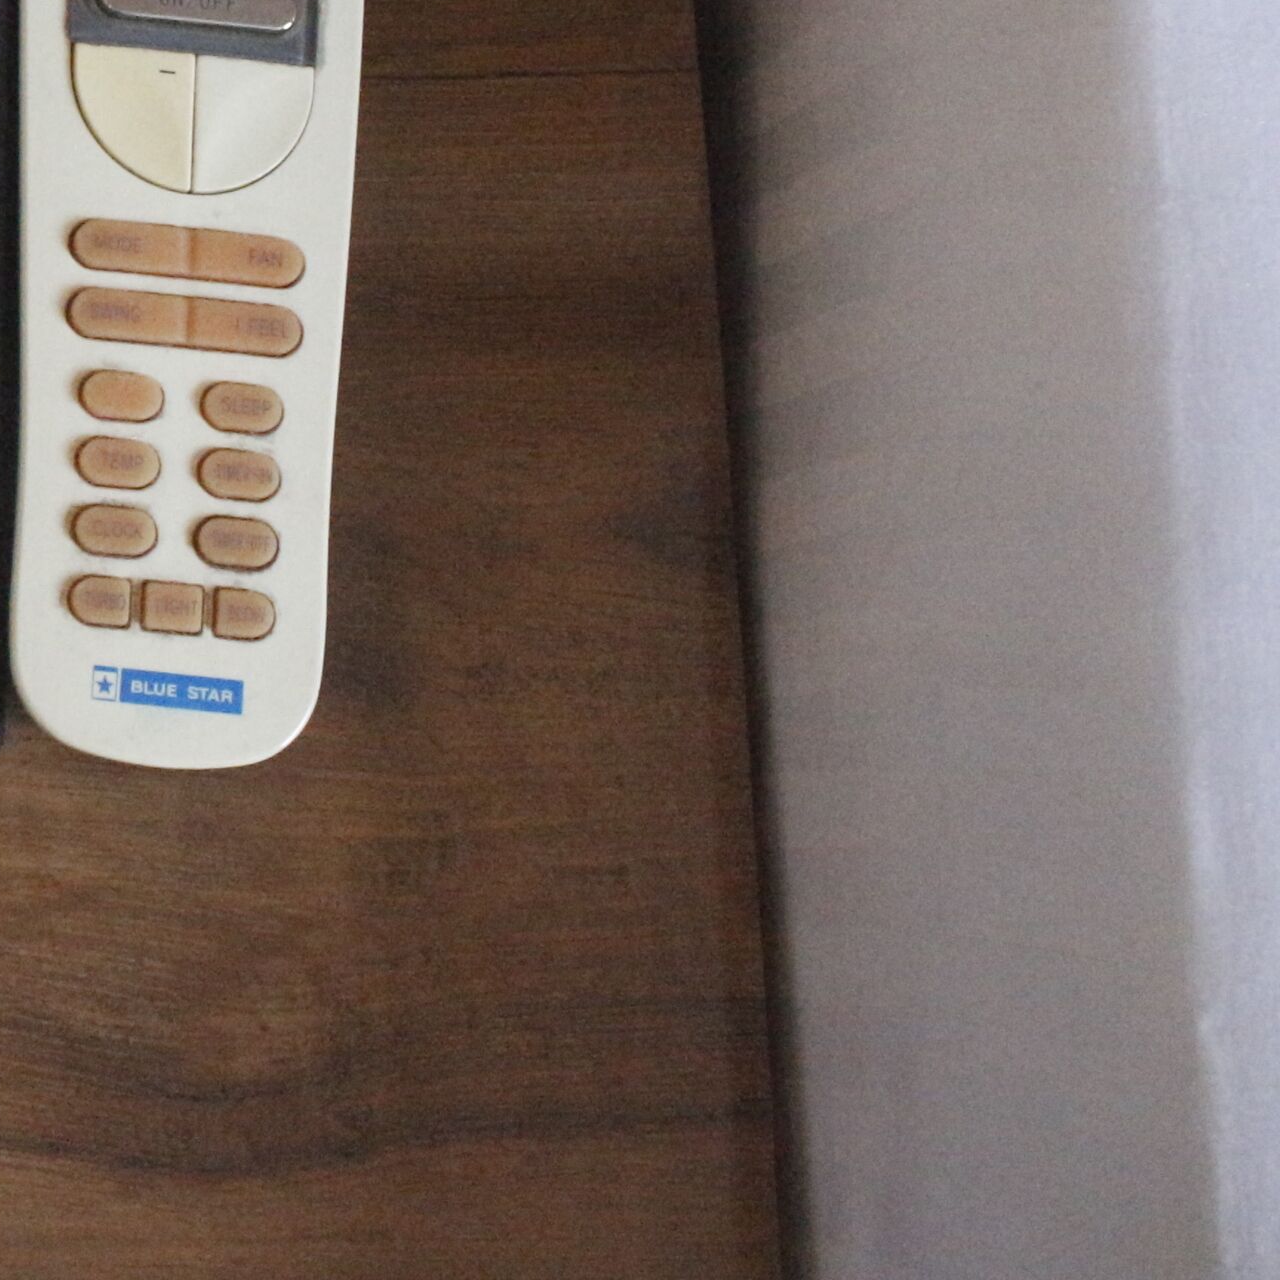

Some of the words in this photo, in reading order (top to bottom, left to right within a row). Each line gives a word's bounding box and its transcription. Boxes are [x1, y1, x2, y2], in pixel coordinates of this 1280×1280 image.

[93, 233, 142, 254] MODE
[248, 248, 284, 268] FAN
[220, 395, 272, 416] SLEEP
[100, 450, 144, 471] TEMP
[130, 681, 177, 698] BLUE
[187, 685, 233, 703] STAR
